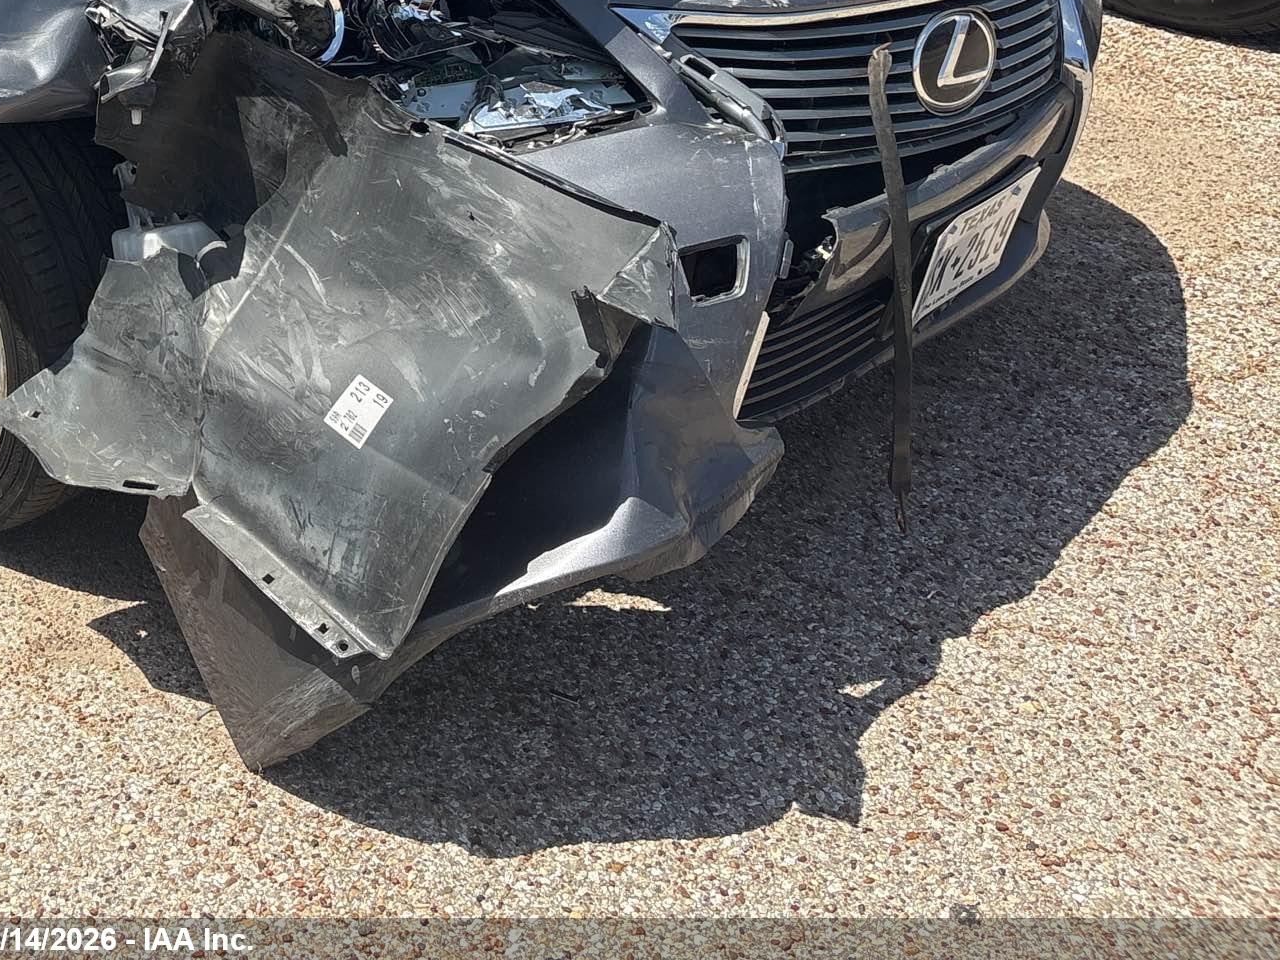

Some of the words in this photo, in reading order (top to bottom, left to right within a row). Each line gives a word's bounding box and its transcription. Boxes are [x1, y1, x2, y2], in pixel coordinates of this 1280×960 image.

[960, 195, 1007, 235] TEXAS
[350, 381, 370, 403] 213
[372, 393, 389, 409] 19
